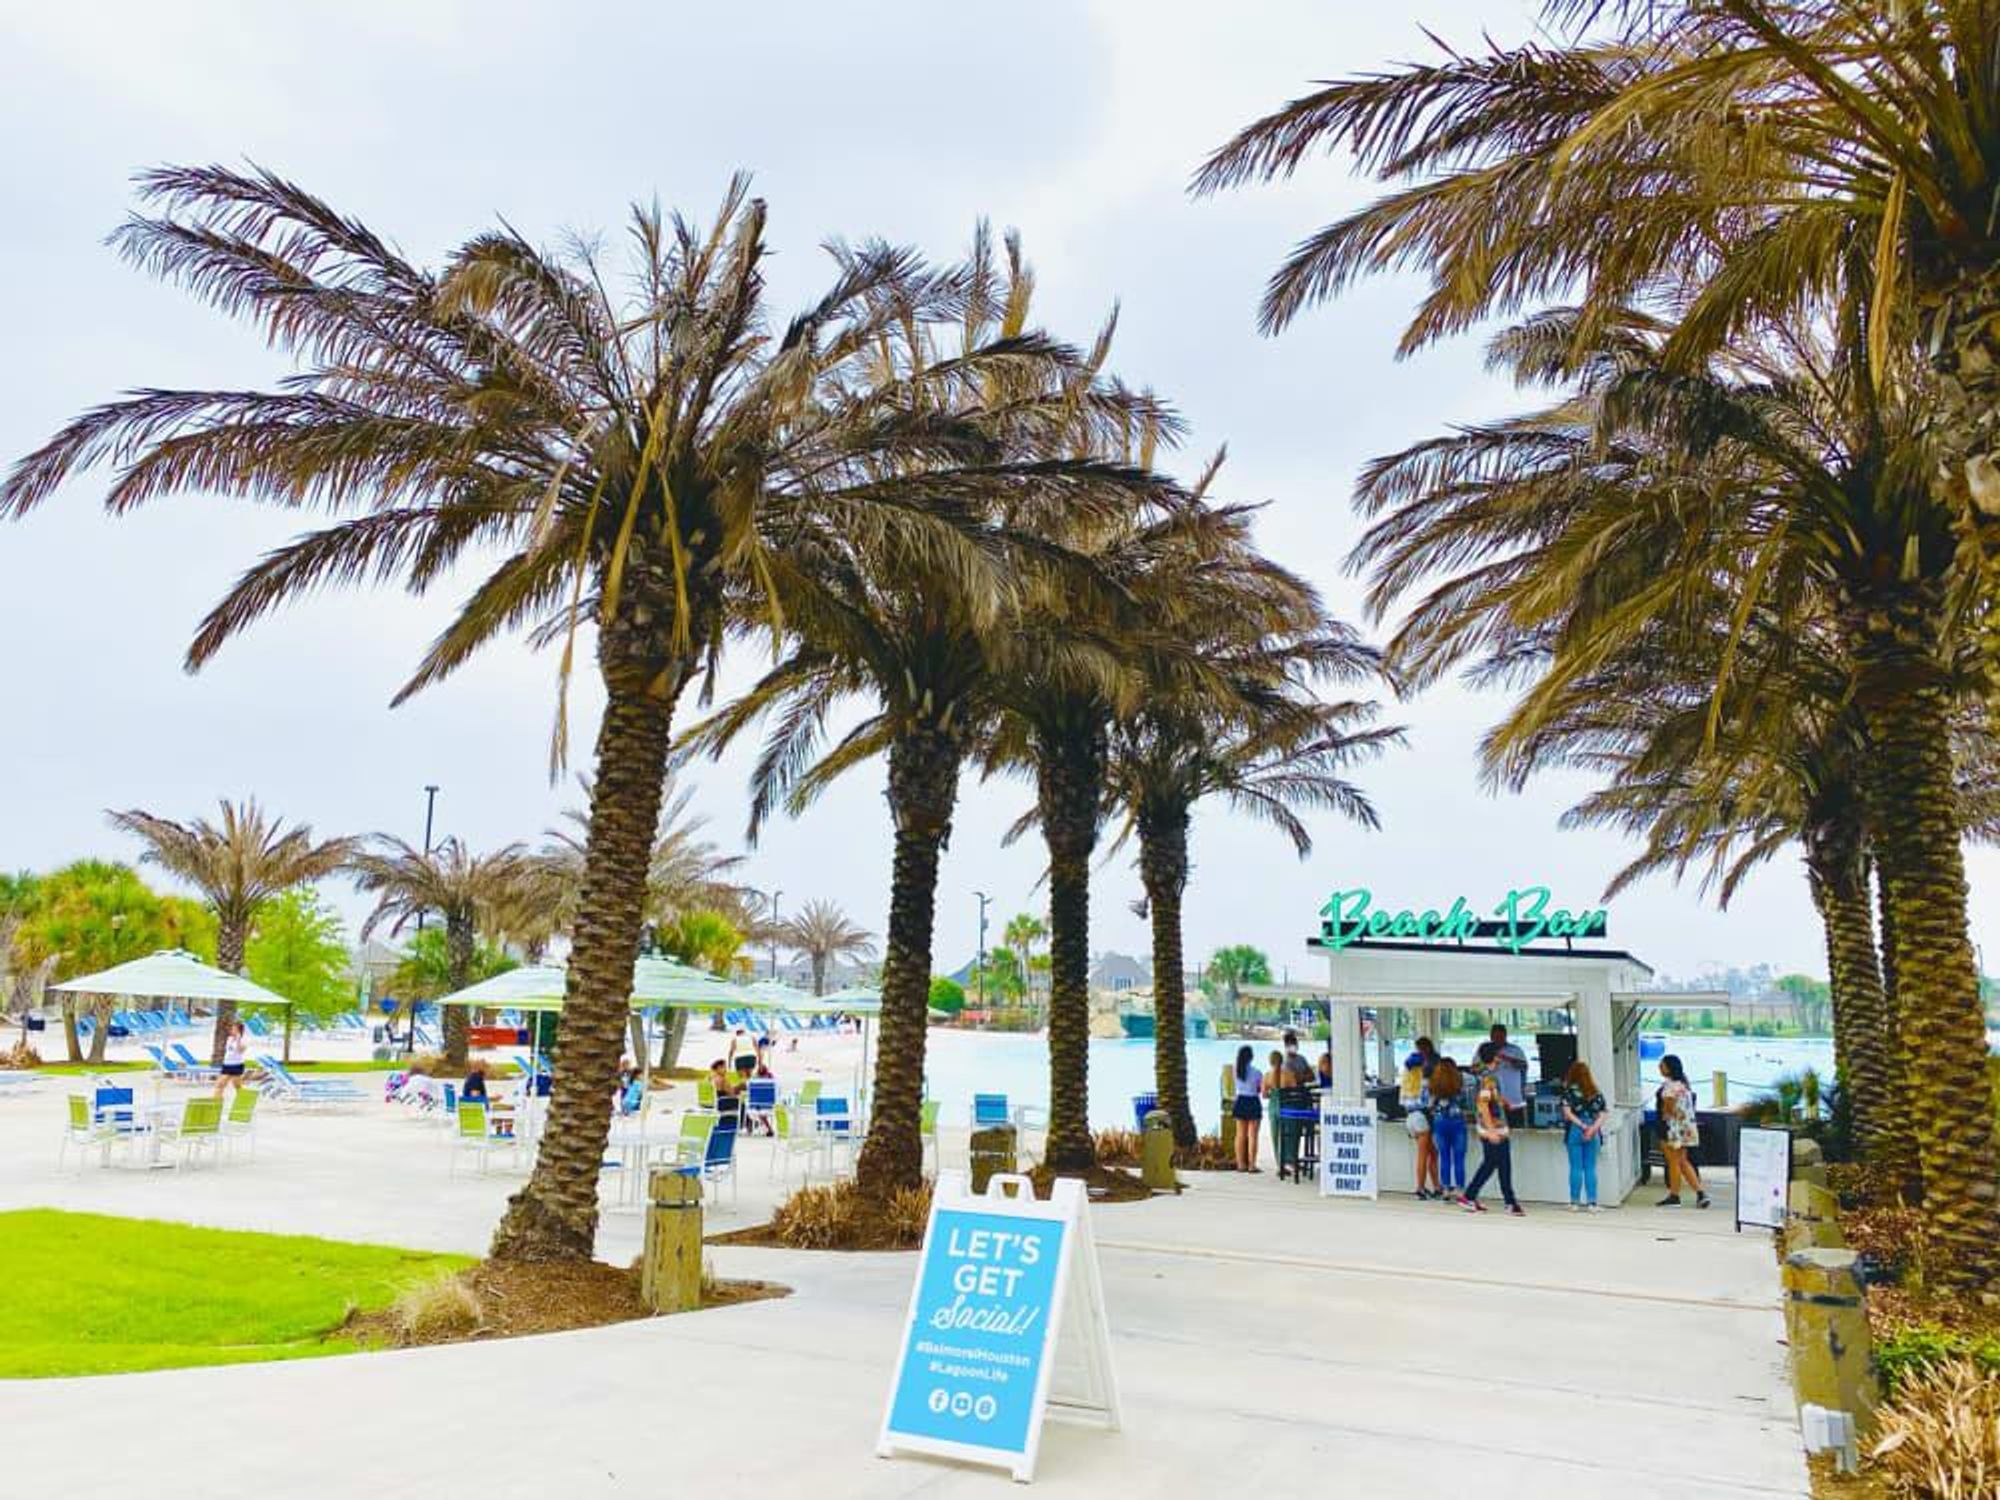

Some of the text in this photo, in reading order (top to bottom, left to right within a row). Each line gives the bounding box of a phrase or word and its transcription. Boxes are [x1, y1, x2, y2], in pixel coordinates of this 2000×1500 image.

[1319, 886, 1608, 955] Beach Bar
[1324, 1114, 1339, 1125] NO
[1333, 1132, 1363, 1144] DEBIT
[1338, 1148, 1359, 1159] AND
[1330, 1163, 1368, 1175] CREDIT
[1336, 1178, 1361, 1190] ONLY
[948, 1228, 1041, 1265] LET'S
[954, 1263, 1024, 1298] GET
[930, 1294, 1040, 1335] Social!
